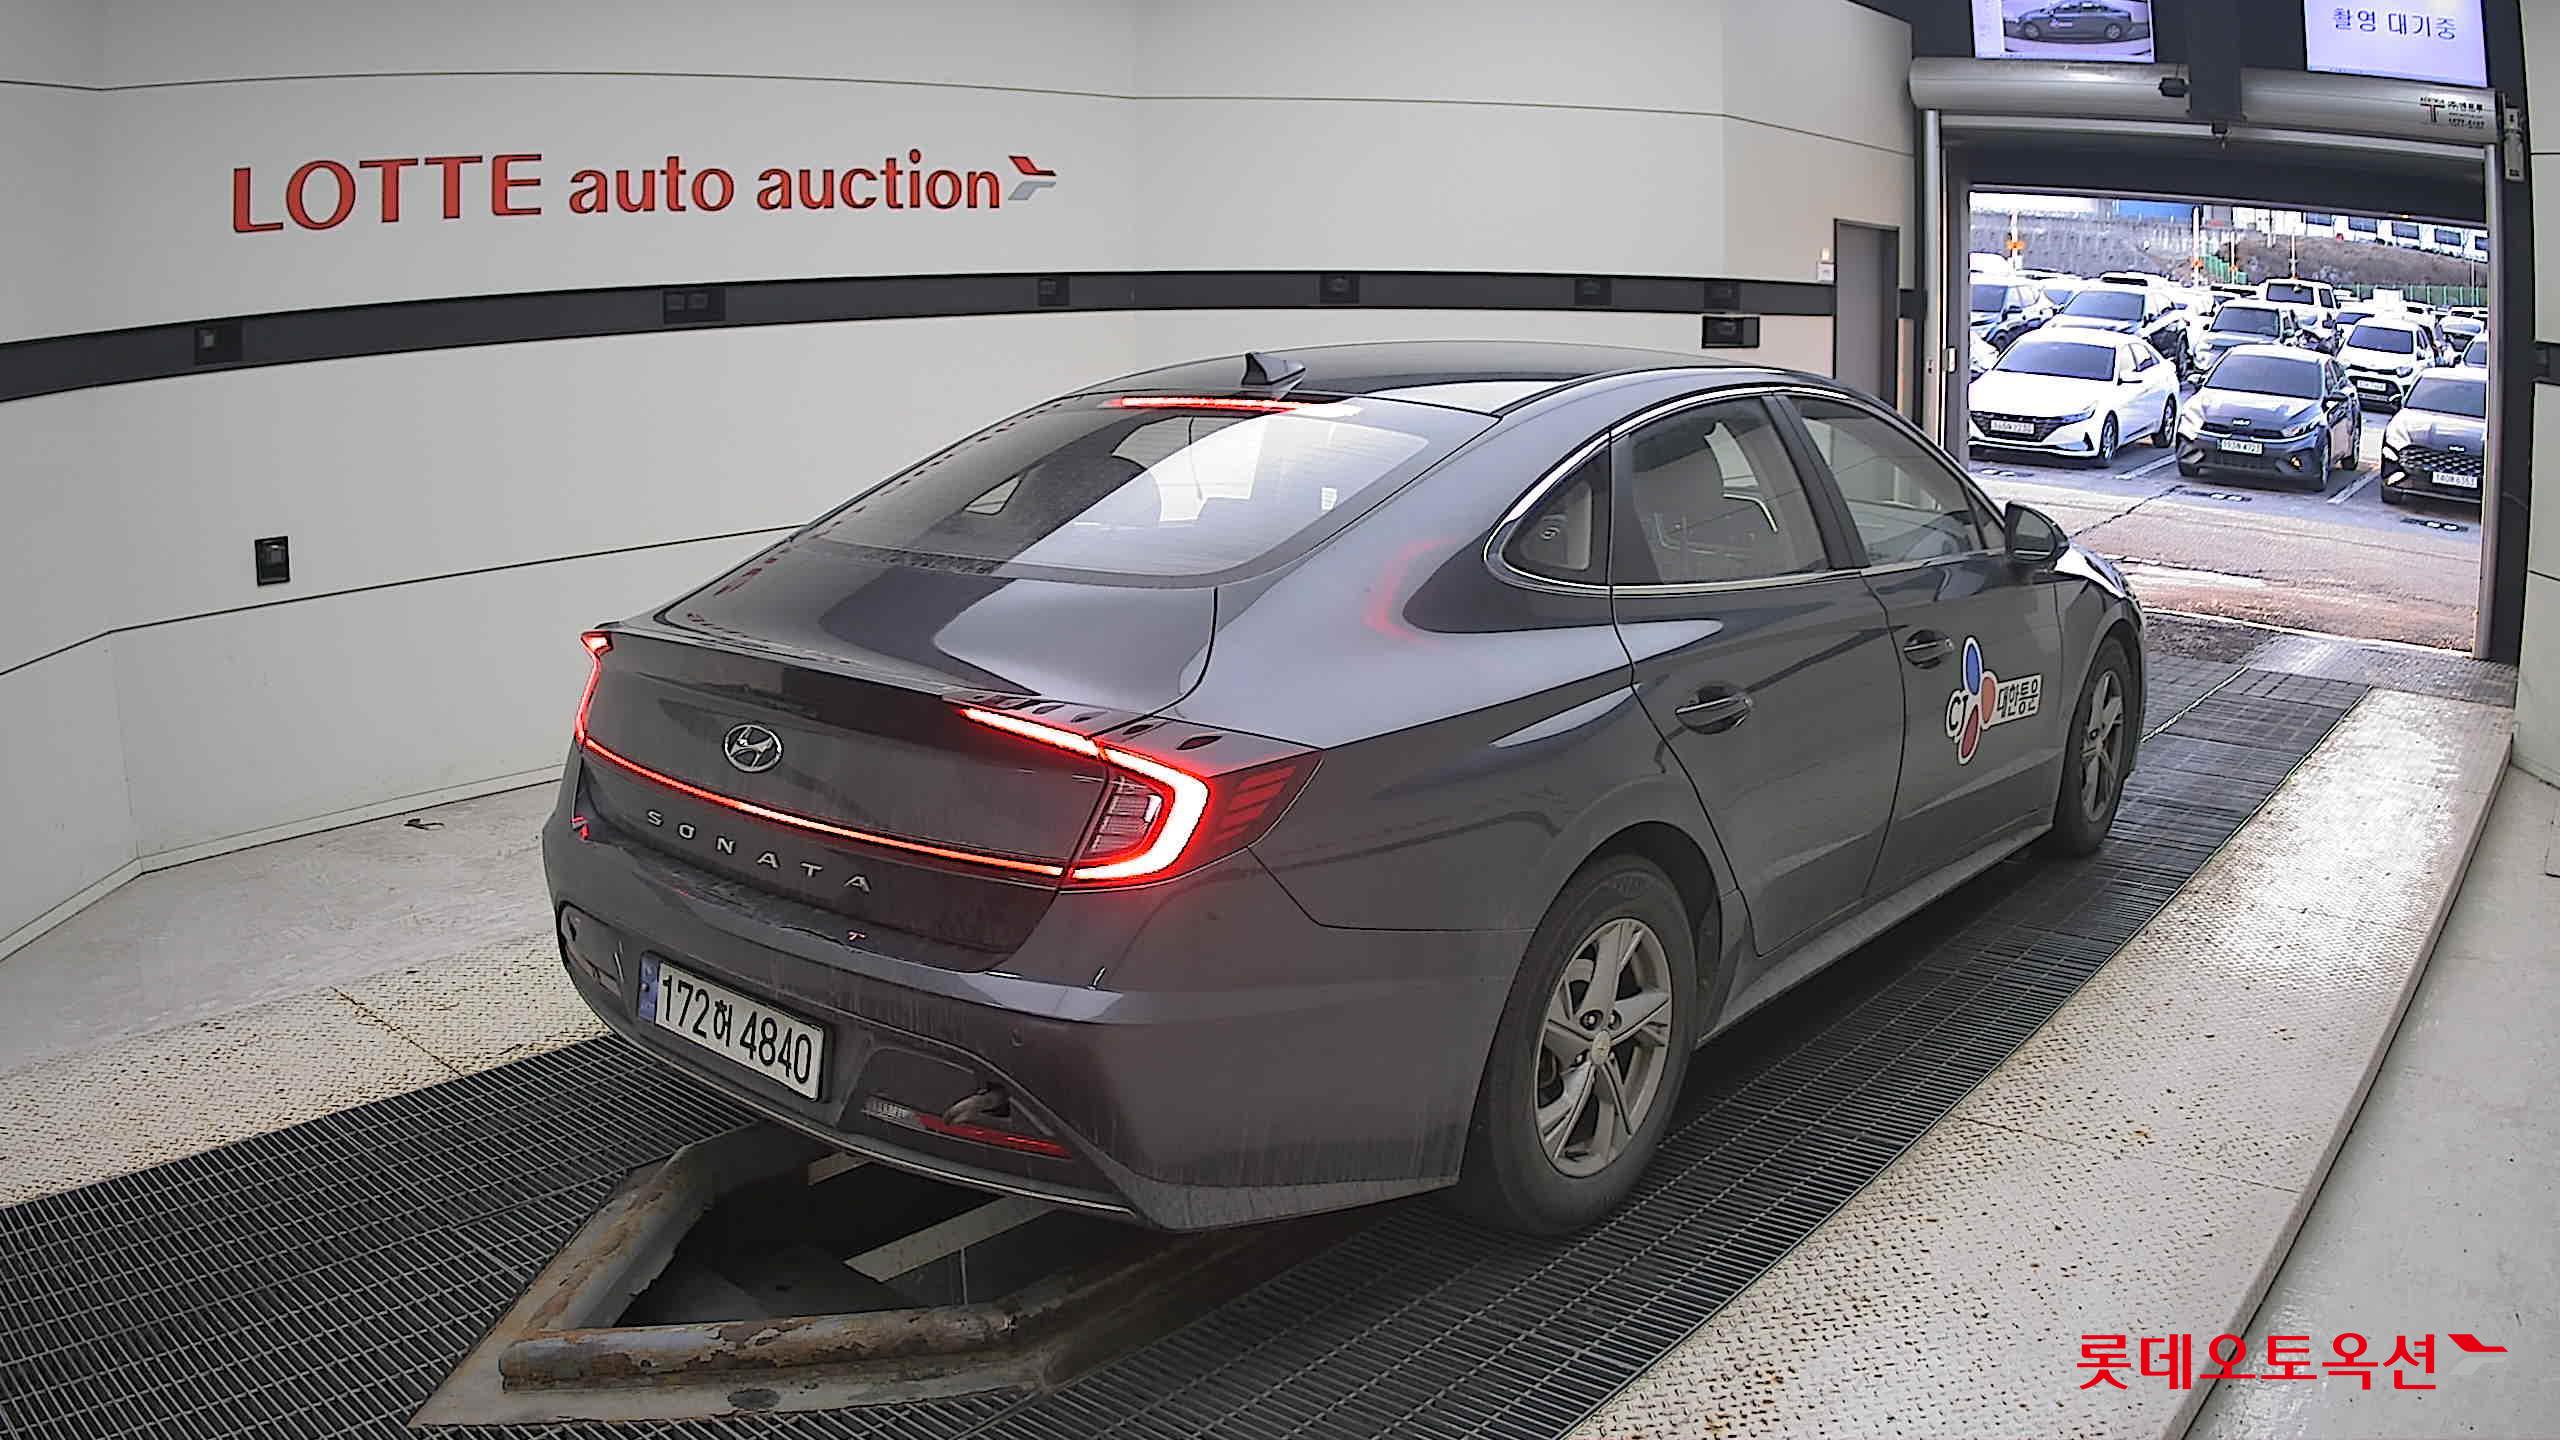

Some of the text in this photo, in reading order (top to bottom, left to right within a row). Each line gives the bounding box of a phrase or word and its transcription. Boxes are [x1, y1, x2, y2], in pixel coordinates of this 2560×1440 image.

[2387, 12, 2457, 40] 대기중
[233, 149, 1001, 233] LOTTE auto auction
[1949, 694, 1968, 737] CJ
[647, 809, 872, 894] SONATA
[662, 974, 813, 1085] 172허 4840
